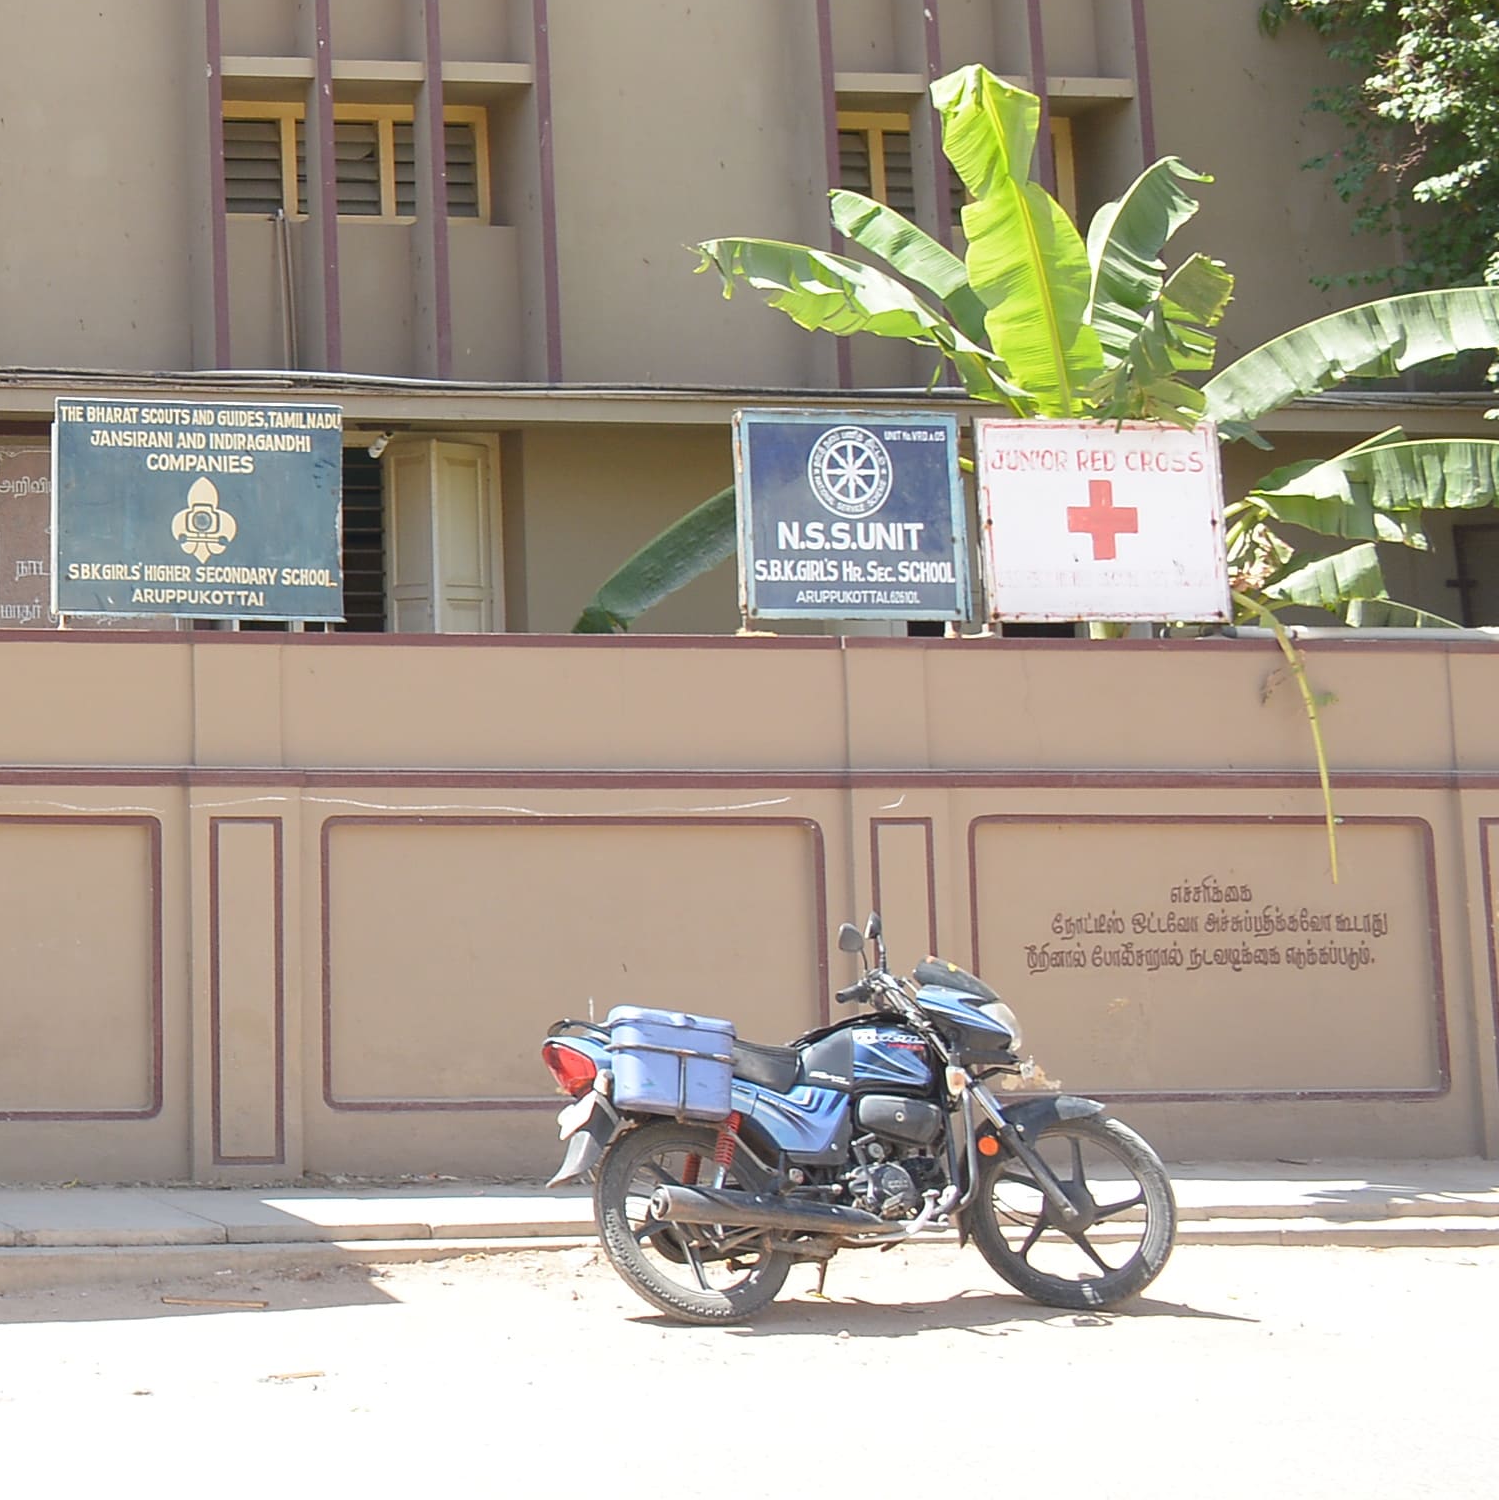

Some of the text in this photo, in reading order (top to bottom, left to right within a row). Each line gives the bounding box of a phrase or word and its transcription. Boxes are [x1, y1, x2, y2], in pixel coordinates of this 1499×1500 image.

[60, 406, 83, 422] THE
[87, 407, 138, 425] BHARAT
[141, 409, 190, 426] SCOUTS
[192, 410, 214, 426] AND
[90, 430, 311, 452] JANSIRANI AND INDIRAGANDHI
[146, 454, 254, 474] COMPANIES
[1076, 449, 1116, 472] RED
[1124, 451, 1204, 473] CROSS
[144, 565, 191, 583] HIGHER
[196, 566, 277, 586] SECONDARY
[281, 568, 337, 587] SCHOOL
[898, 561, 956, 583] SCHOOL
[131, 588, 264, 607] ARUPPUKOTTAI
[1170, 875, 1253, 903] எச்சரிக்கை
[1132, 912, 1198, 934] ஒட்டவோ
[1336, 912, 1388, 938] கூடாது
[1187, 941, 1280, 971] நடவடிக்கை
